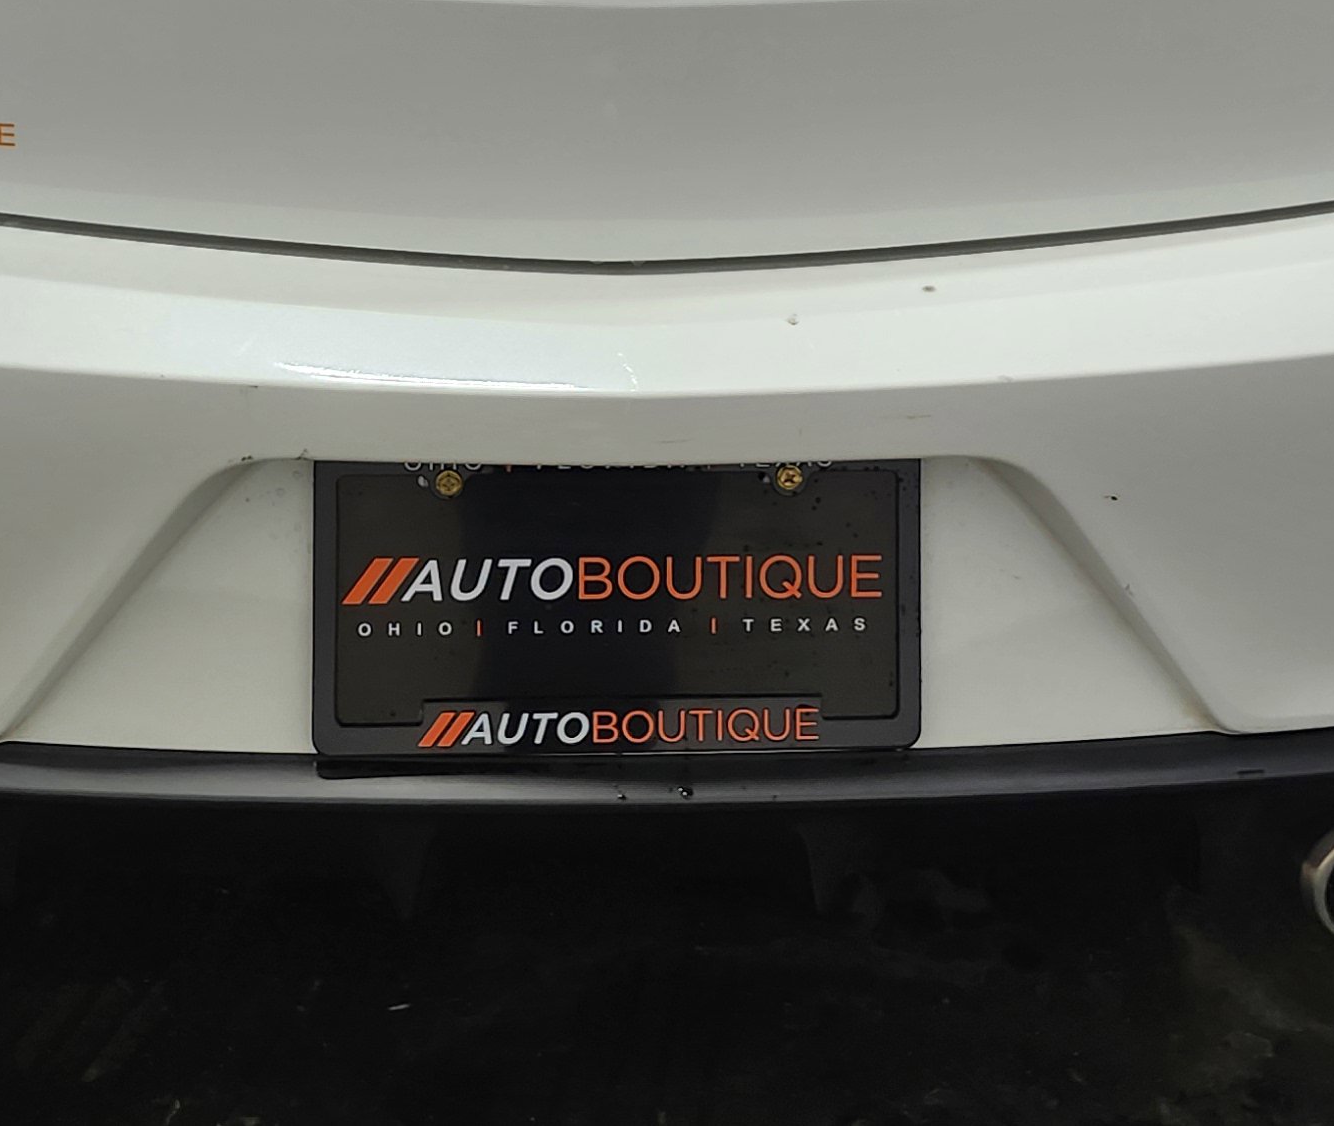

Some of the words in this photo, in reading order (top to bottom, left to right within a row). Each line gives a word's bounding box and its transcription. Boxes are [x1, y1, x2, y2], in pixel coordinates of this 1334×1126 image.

[400, 555, 883, 603] AUTOBOUTIQUE
[357, 620, 455, 637] OHIO
[507, 619, 682, 636] FLORIDA
[742, 617, 868, 634] TEXAS
[460, 708, 819, 746] AUTOBOUTIQUE
